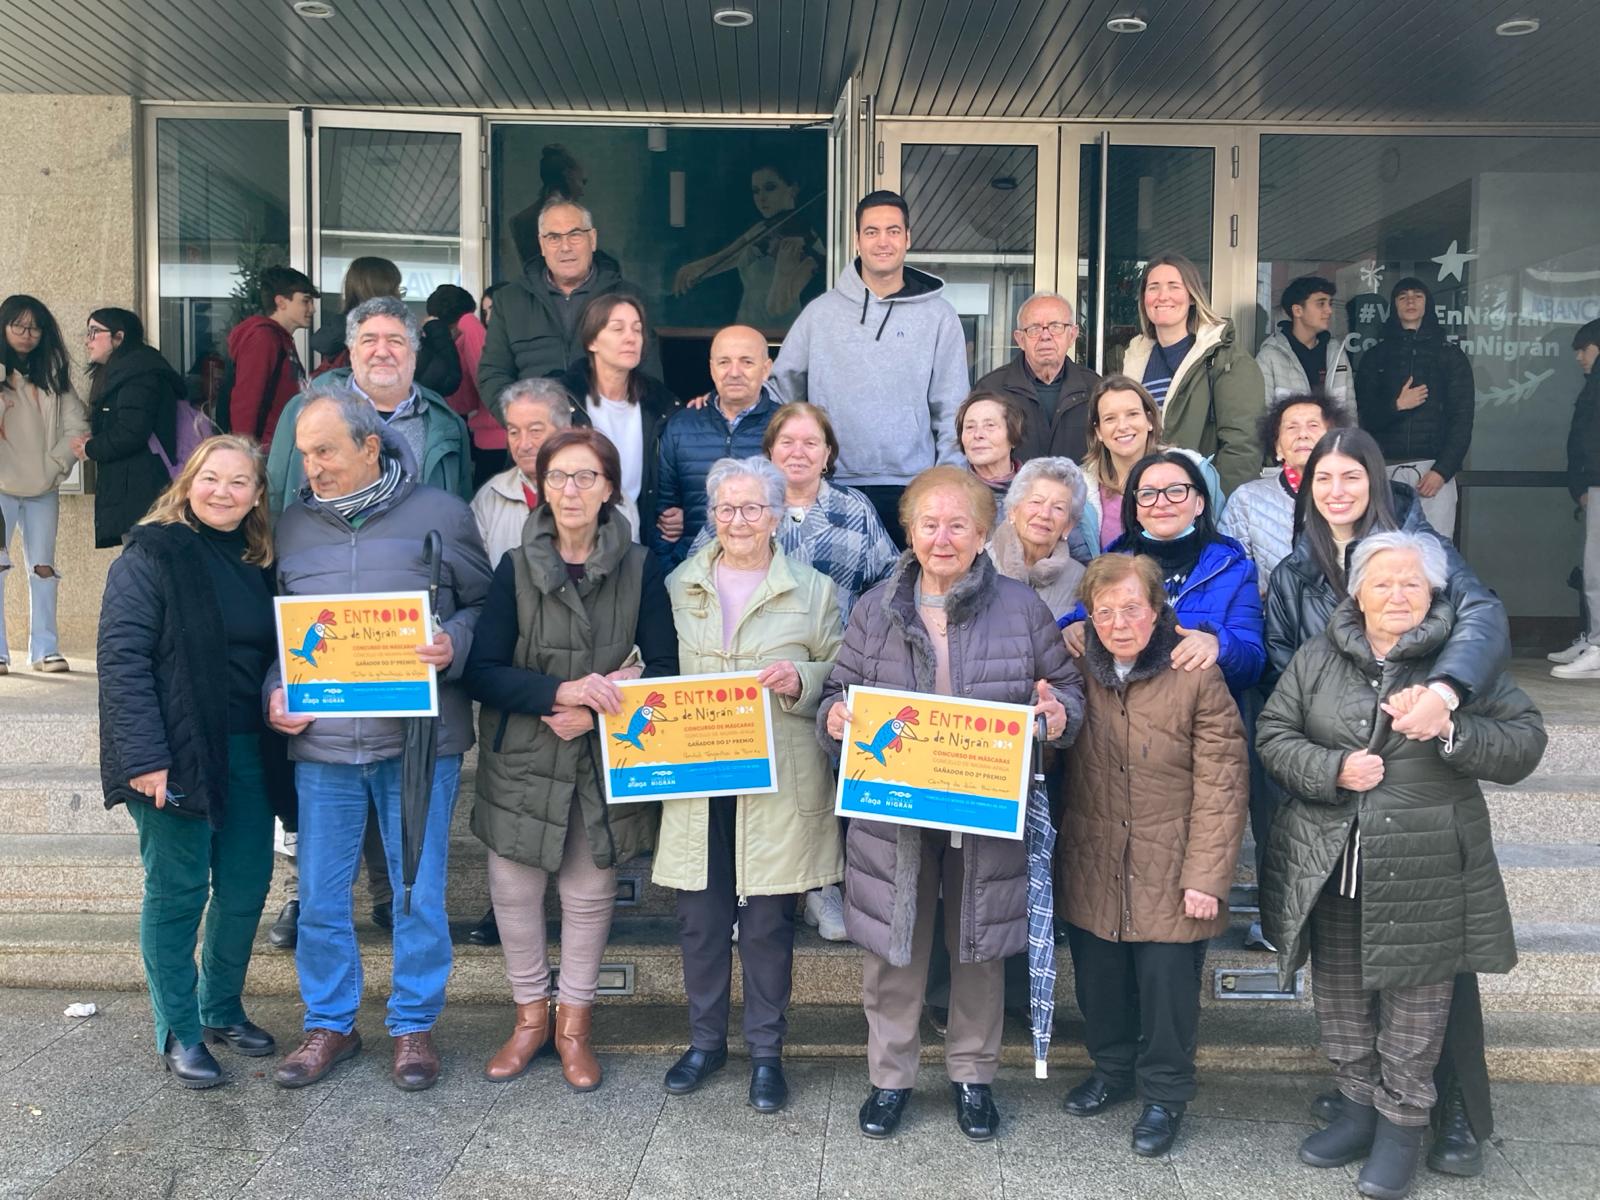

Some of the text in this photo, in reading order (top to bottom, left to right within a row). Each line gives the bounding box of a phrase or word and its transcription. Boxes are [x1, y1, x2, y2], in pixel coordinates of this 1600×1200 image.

[344, 608, 419, 624] ENTROIDO
[351, 627, 360, 639] de
[363, 627, 397, 642] Nigrán
[674, 687, 758, 705] ENTROIDO
[683, 705, 753, 722] de Nigrán 2024
[929, 710, 1020, 736] ENTROIDO
[688, 739, 715, 747] GAÑADOR
[934, 730, 1013, 750] de Nigrán 2024
[932, 750, 968, 759] CONCURSO
[933, 766, 963, 776] GAÑADOR
[982, 773, 1007, 781] PREMIO
